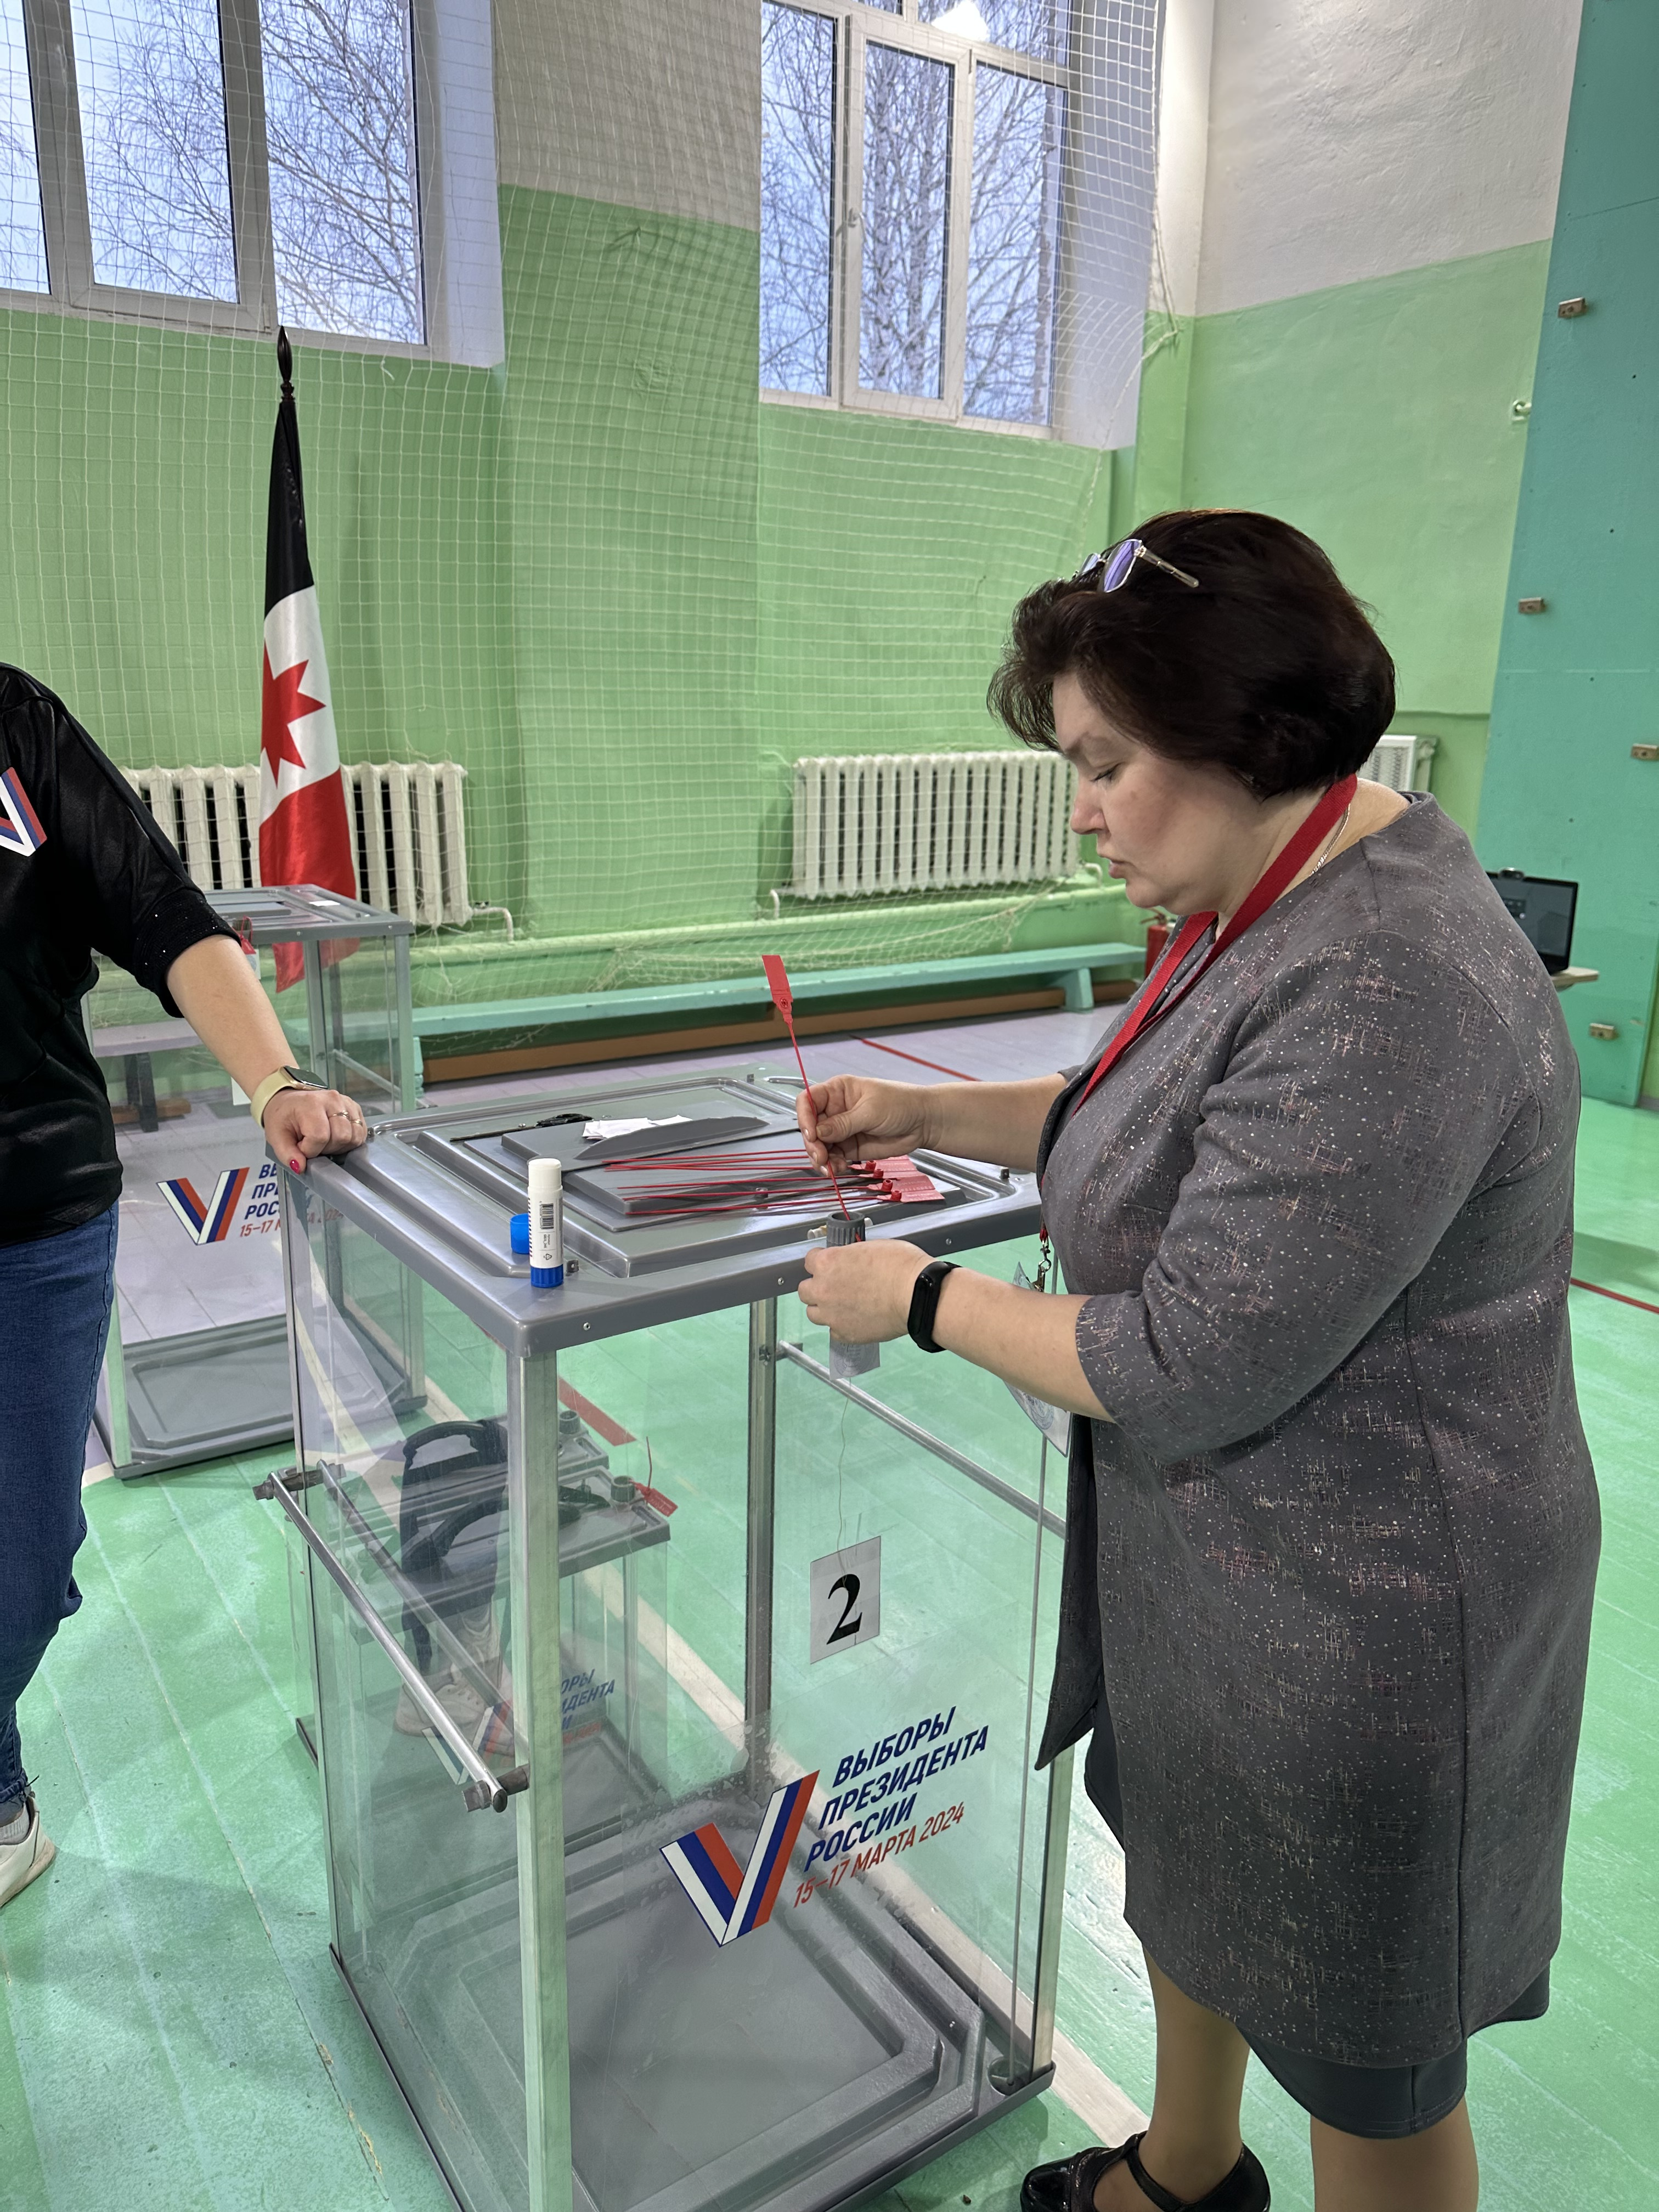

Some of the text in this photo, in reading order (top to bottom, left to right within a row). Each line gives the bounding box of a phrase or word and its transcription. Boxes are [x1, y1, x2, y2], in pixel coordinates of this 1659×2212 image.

[244, 1201, 280, 1220] РОС
[826, 1573, 862, 1645] 2
[562, 1668, 595, 1694] ОРЫ
[562, 1679, 615, 1714] ДЕНТА
[818, 1725, 989, 1830] ПРЕЗИДЕНТА
[832, 1706, 956, 1787] ВЫБОРЫ
[793, 1801, 964, 1908] 15–17 МАРТА 2024
[804, 1792, 917, 1872] РОССИИ
